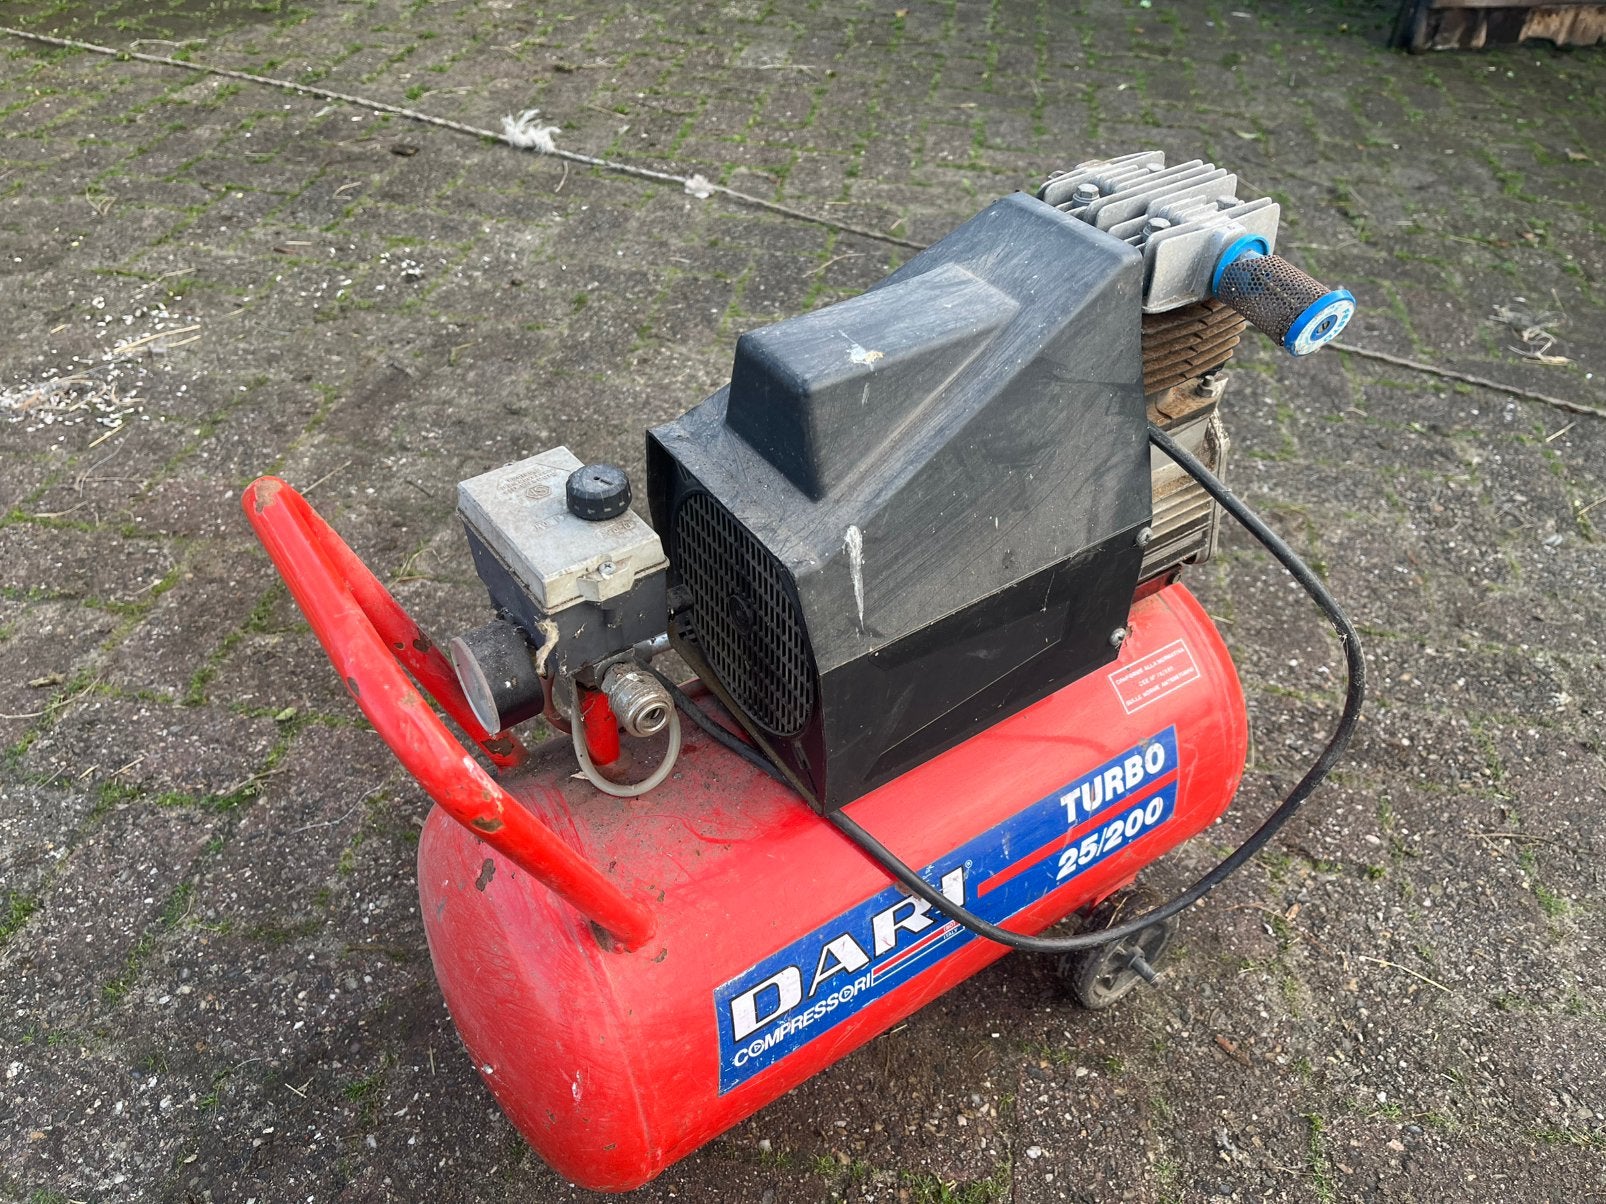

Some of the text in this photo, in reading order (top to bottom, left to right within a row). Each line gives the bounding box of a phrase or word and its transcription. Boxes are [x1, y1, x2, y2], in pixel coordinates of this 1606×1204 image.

[1060, 742, 1165, 824] TURBO
[1056, 796, 1164, 881] 25/200
[729, 864, 966, 1044] DARI
[943, 928, 958, 940] ITALY
[733, 972, 872, 1067] COMPRESSORI
